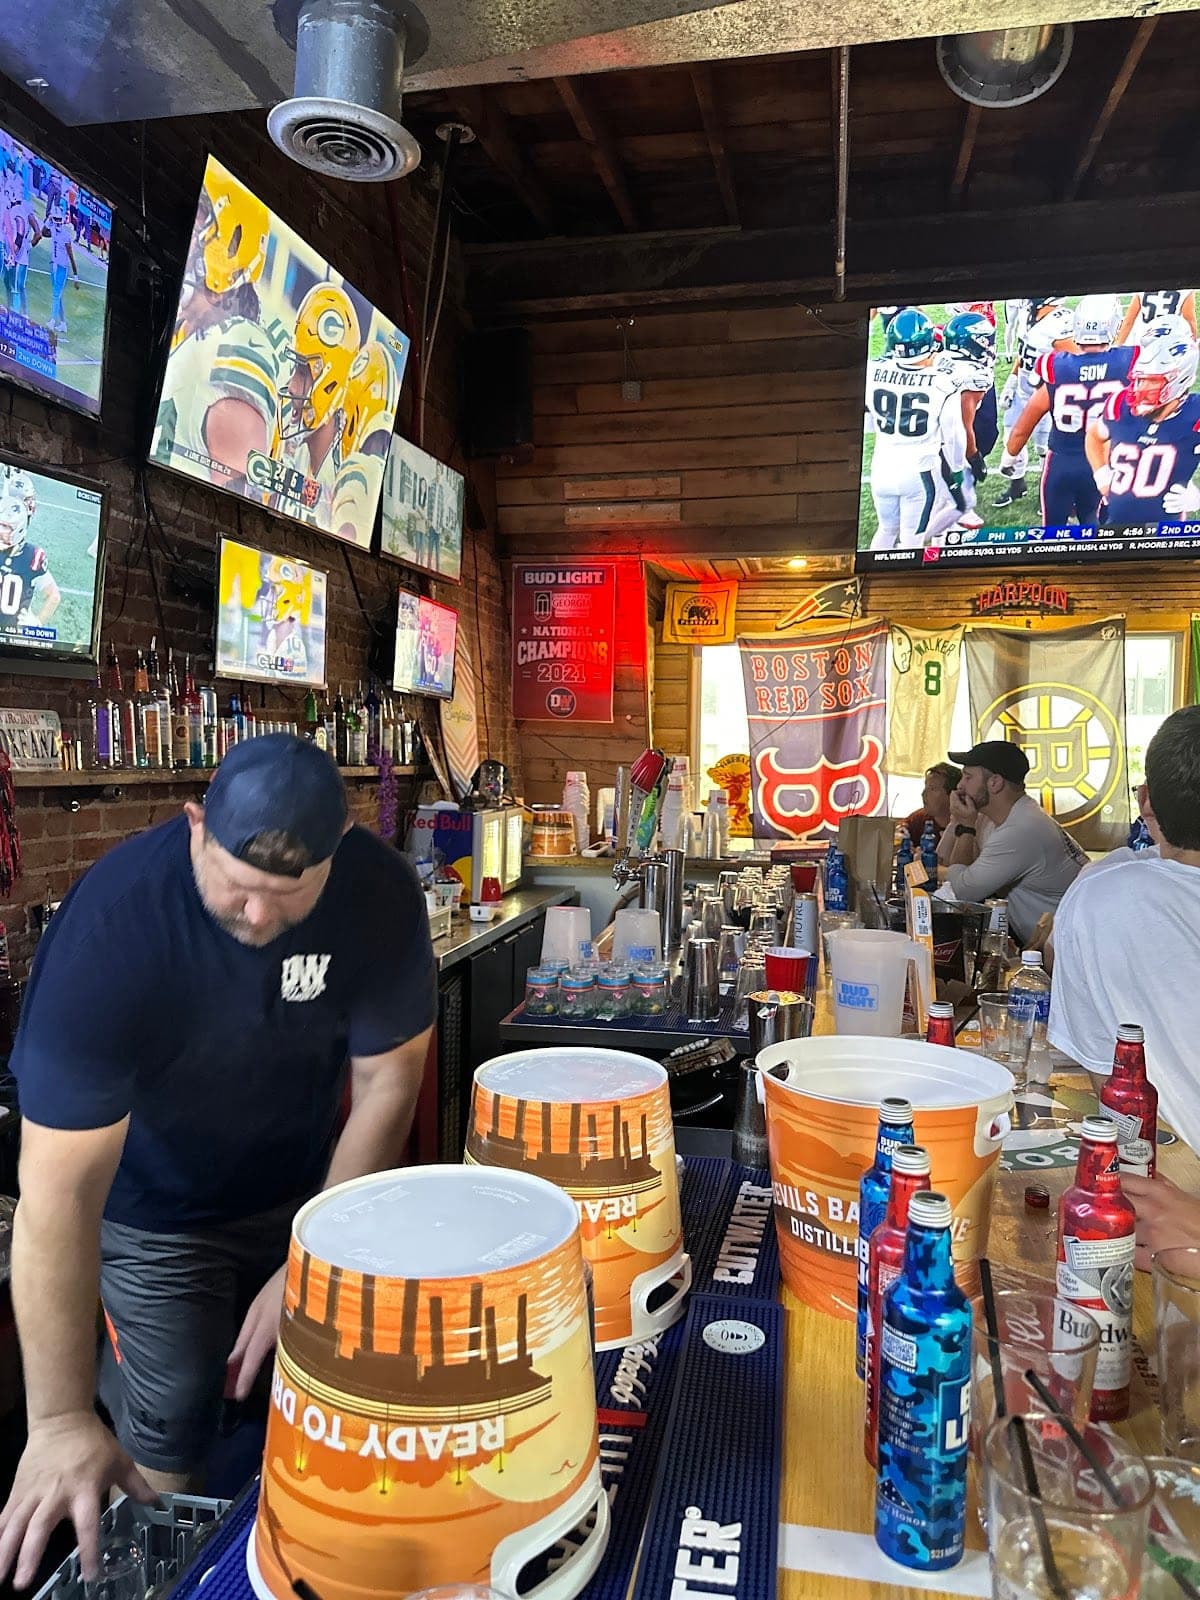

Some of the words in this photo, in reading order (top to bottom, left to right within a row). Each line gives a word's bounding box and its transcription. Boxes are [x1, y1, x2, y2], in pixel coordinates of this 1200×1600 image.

[1142, 291, 1181, 323] 53
[32, 358, 53, 375] DOWN
[1079, 363, 1108, 382] SOW
[873, 369, 937, 387] BARNETT
[872, 389, 931, 437] 96
[274, 465, 286, 483] 24
[290, 473, 297, 488] 6
[1109, 444, 1177, 497] 60
[988, 532, 1005, 541] PHI
[1014, 530, 1026, 540] 19
[1056, 529, 1071, 538] NE
[1081, 528, 1092, 537] 14
[1097, 528, 1115, 537] 3RD
[1123, 527, 1143, 536] 4:56
[1161, 525, 1181, 534] 2ND
[889, 551, 911, 560] WEEK
[1033, 544, 1068, 553] CONNER:
[1108, 542, 1124, 550] YDS
[1137, 540, 1168, 549] MOORE:
[524, 571, 556, 585] BUD
[557, 571, 603, 584] LIGHT
[977, 582, 1068, 612] HARPOON
[36, 628, 55, 638] DOWN
[532, 626, 592, 637] NATIONAL
[517, 640, 608, 666] CHAMPIONS
[914, 637, 956, 656] WALKER
[751, 641, 873, 682] BOSTON
[537, 663, 586, 683] 2021
[925, 660, 941, 696] 8
[550, 694, 573, 707] DW
[755, 685, 809, 713] RED
[819, 673, 874, 710] SOX
[440, 815, 471, 831] Bull
[840, 983, 870, 997] BUD
[838, 993, 876, 1008] LIGHT
[878, 1143, 895, 1156] LIG
[880, 1136, 902, 1149] BUD
[580, 1194, 638, 1224] REA
[712, 1180, 773, 1284] CUTWATER
[303, 1404, 347, 1453] TO
[359, 1414, 506, 1461] READY
